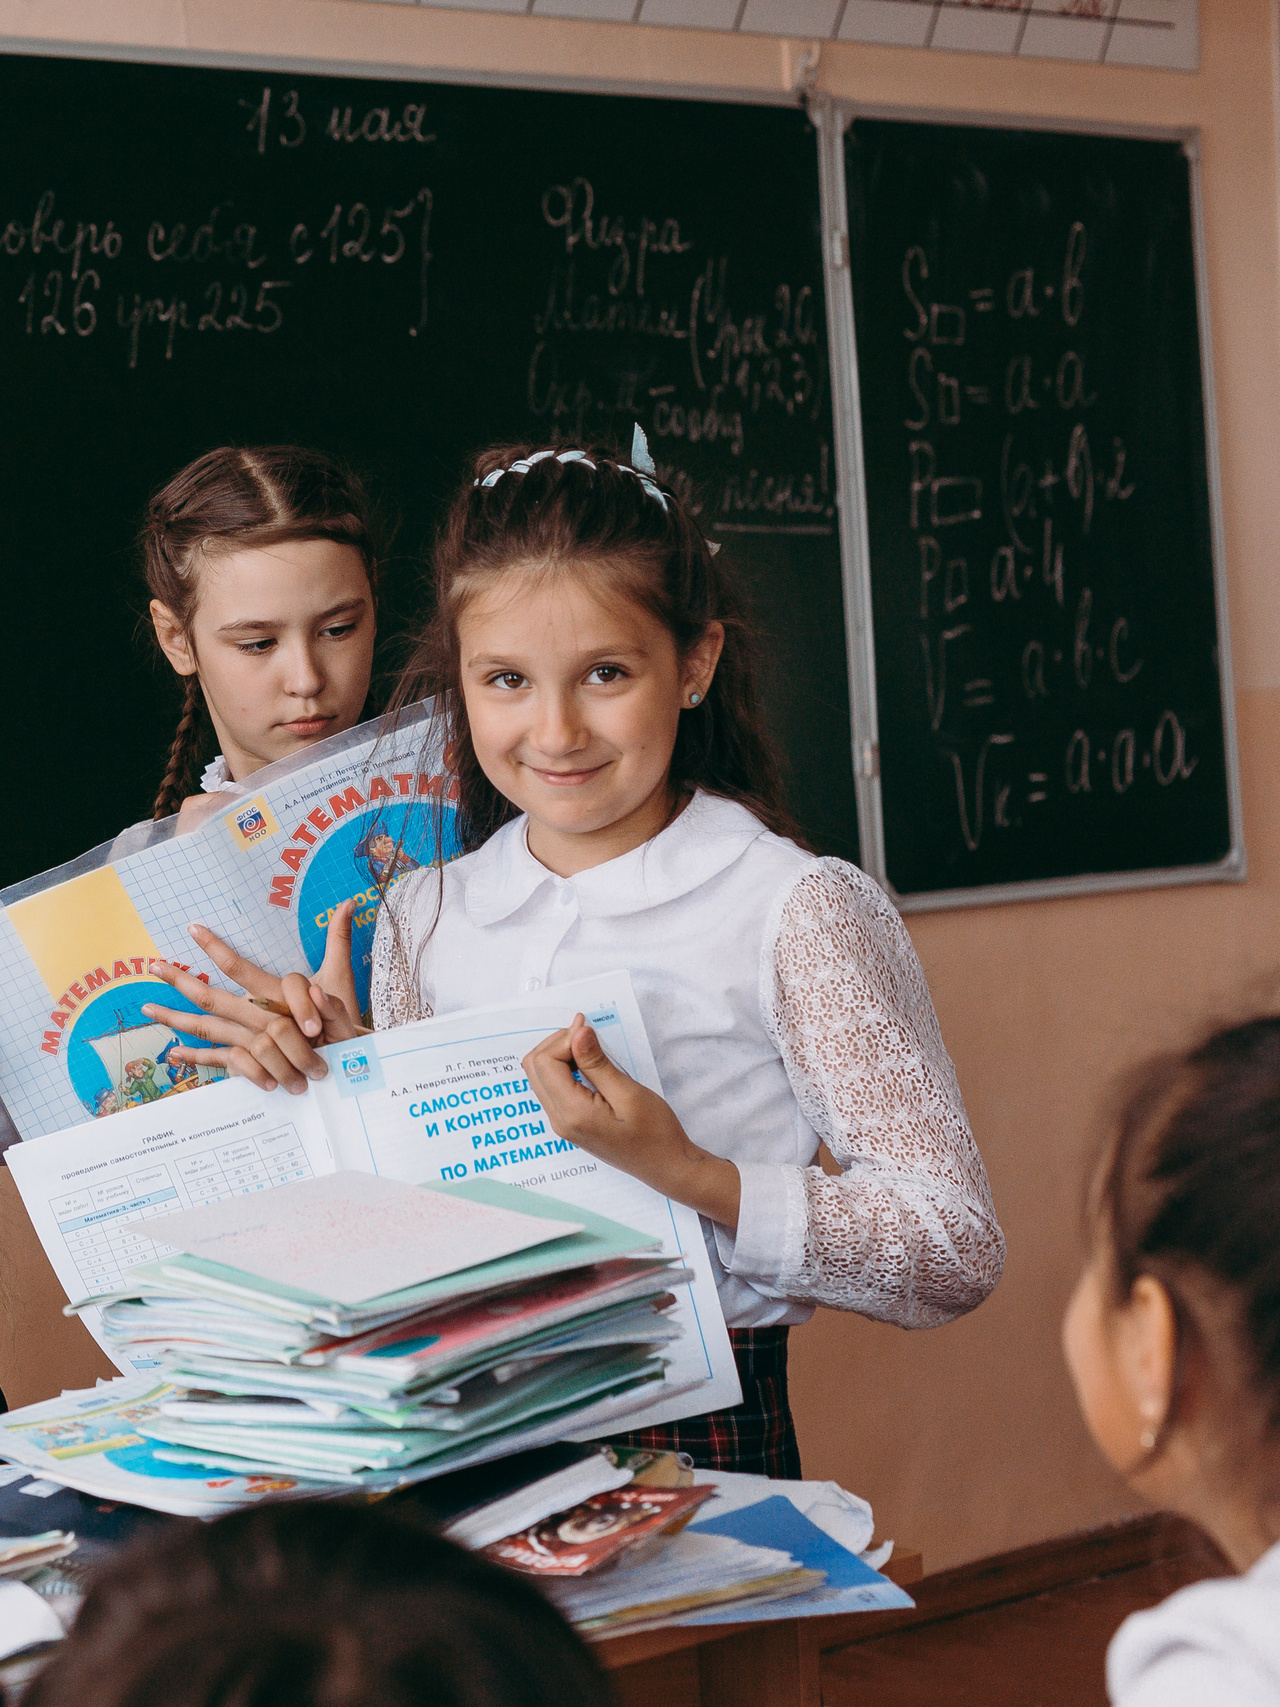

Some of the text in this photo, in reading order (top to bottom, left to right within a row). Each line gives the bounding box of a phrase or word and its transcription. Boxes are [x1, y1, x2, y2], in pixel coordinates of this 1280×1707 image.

[238, 87, 436, 154] 13 мая
[236, 806, 258, 822] ФГОС
[249, 829, 267, 843] НОО
[40, 956, 210, 1057] МАТЕМАТКА
[342, 1050, 364, 1059] ФГОС
[468, 1054, 520, 1068] Петерсон,
[350, 1074, 369, 1084] НОО
[415, 1071, 490, 1092] Невретдинова,
[425, 1099, 542, 1138] И КОНТРОЛЬ
[142, 1129, 175, 1145] ГРАФИК
[471, 1120, 546, 1150] РАБОТЫ
[61, 1161, 108, 1181] проведения
[109, 1140, 179, 1165] самостоятельных
[188, 1120, 240, 1141] контрольных
[242, 1111, 266, 1125] работ
[440, 1138, 581, 1182] ПО МАТЕМАТИК
[551, 1162, 597, 1182] ШКОЛЫ
